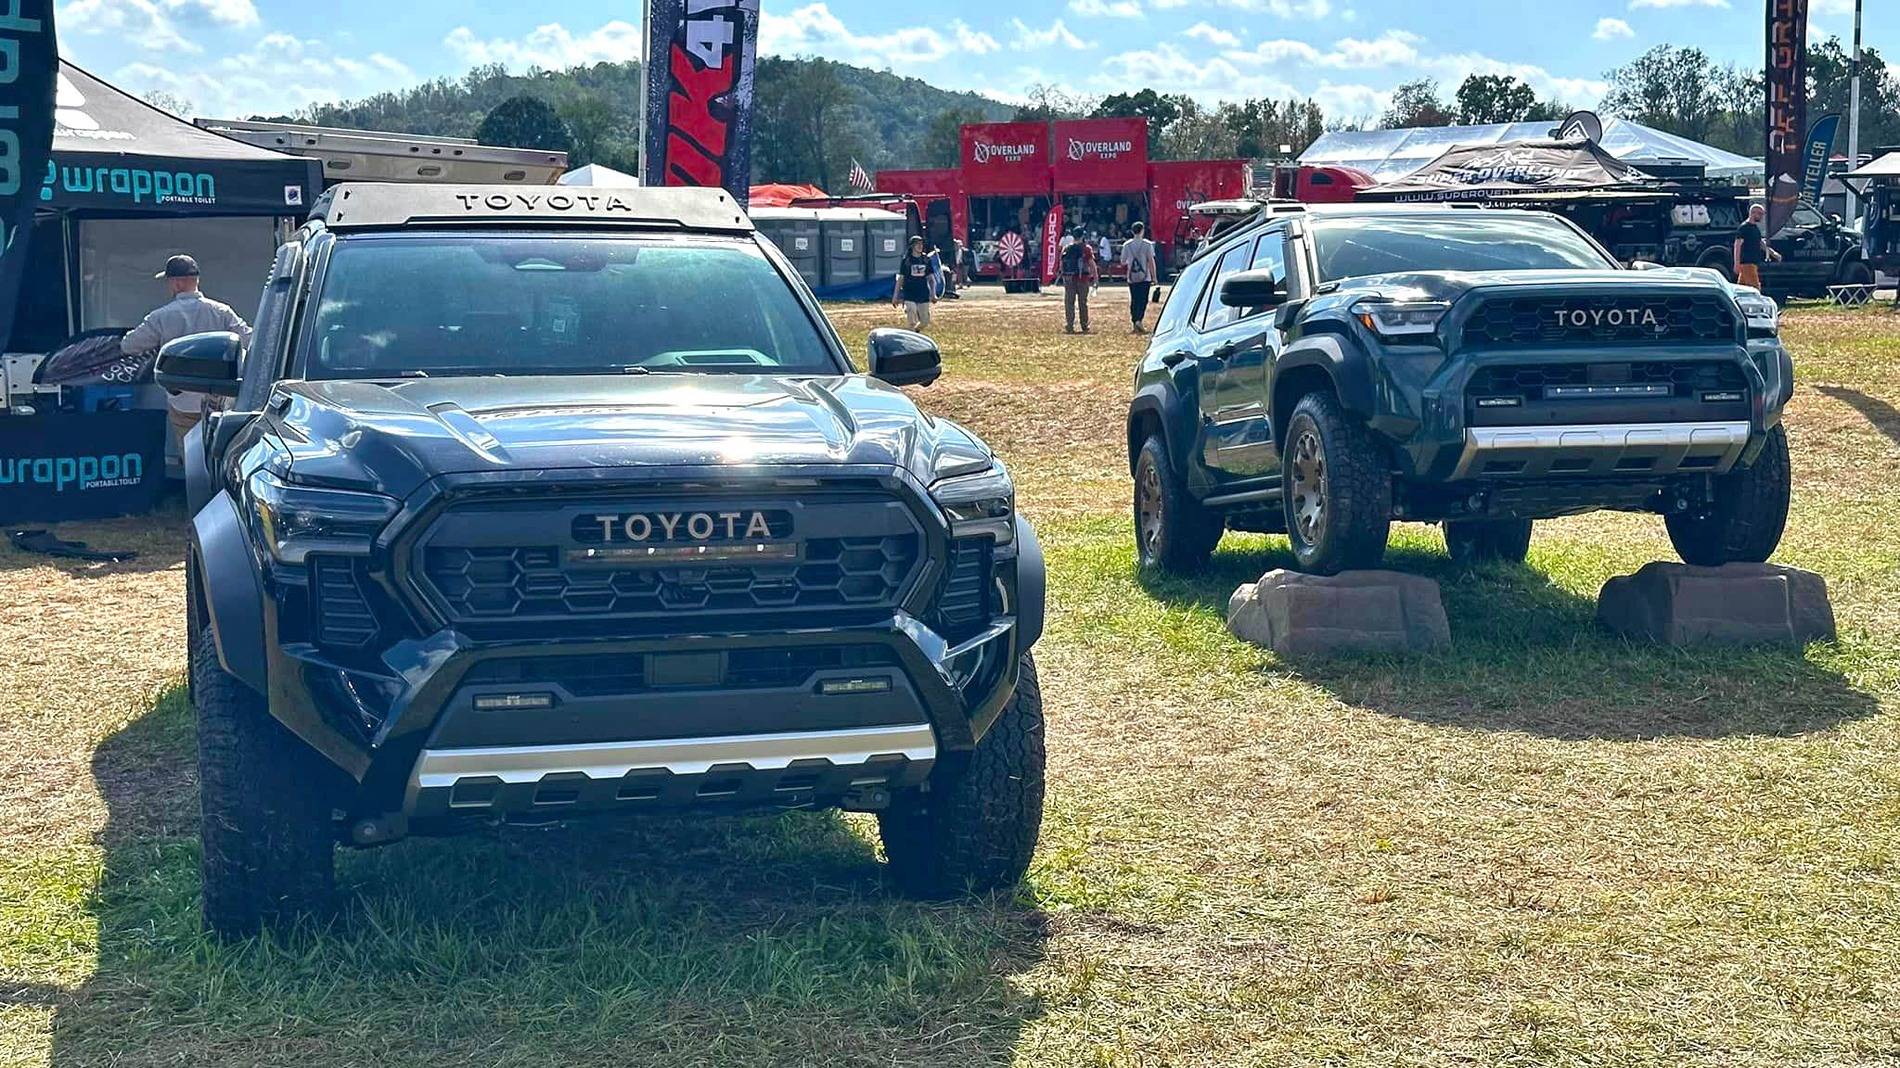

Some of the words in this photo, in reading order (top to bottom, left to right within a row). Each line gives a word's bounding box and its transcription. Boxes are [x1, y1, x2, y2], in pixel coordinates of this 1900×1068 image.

[991, 144, 1035, 155] OVERLAND
[1086, 141, 1132, 153] OVERLAND
[62, 167, 215, 204] wrappon
[161, 195, 194, 203] PORTABLE
[456, 195, 632, 212] TOYOTA
[1047, 213, 1057, 275] REDARC
[1554, 309, 1658, 326] TOYOTA
[596, 512, 771, 542] TOYOTA
